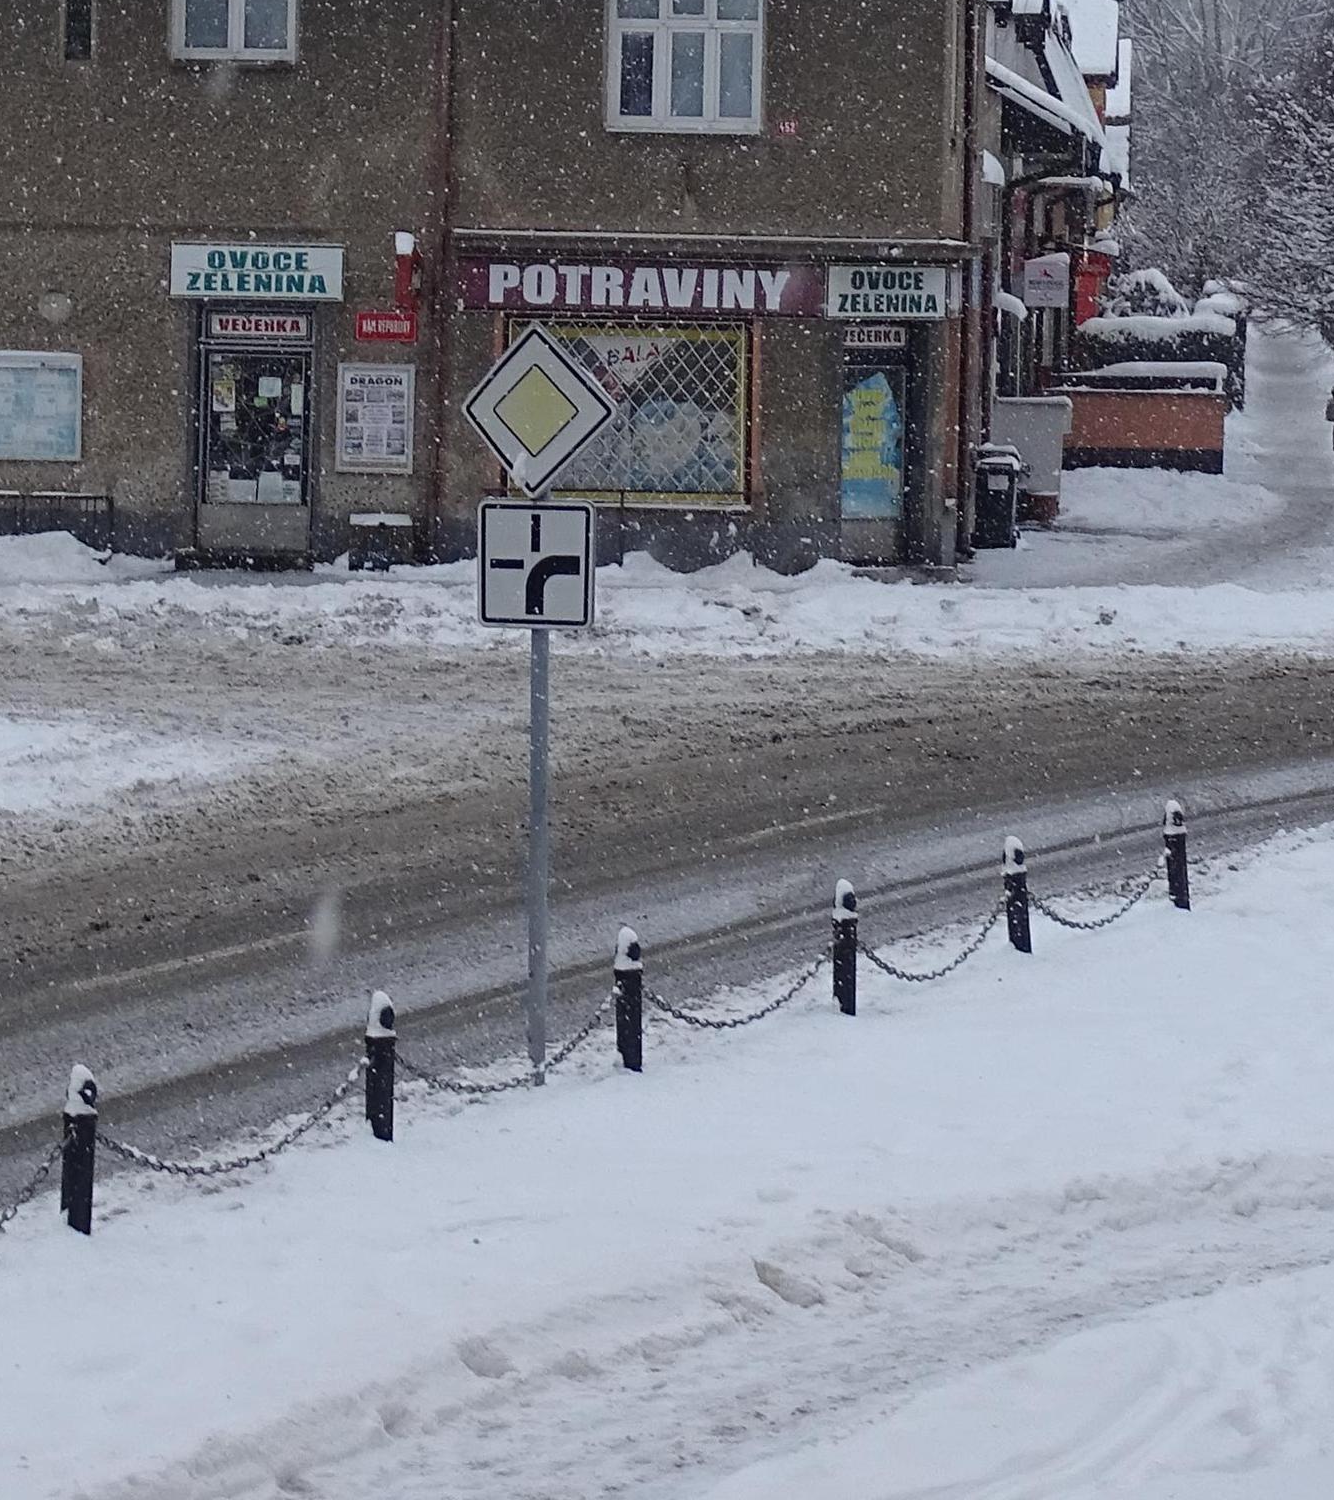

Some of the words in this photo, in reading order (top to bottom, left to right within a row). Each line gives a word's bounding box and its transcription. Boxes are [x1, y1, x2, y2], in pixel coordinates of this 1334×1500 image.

[207, 250, 309, 271] OVOCE
[186, 272, 327, 293] ZELENINA
[488, 263, 791, 311] POTRAVINY
[850, 270, 924, 290] OVOCE
[838, 294, 938, 313] ZELENINA
[350, 377, 403, 386] DRAGON
